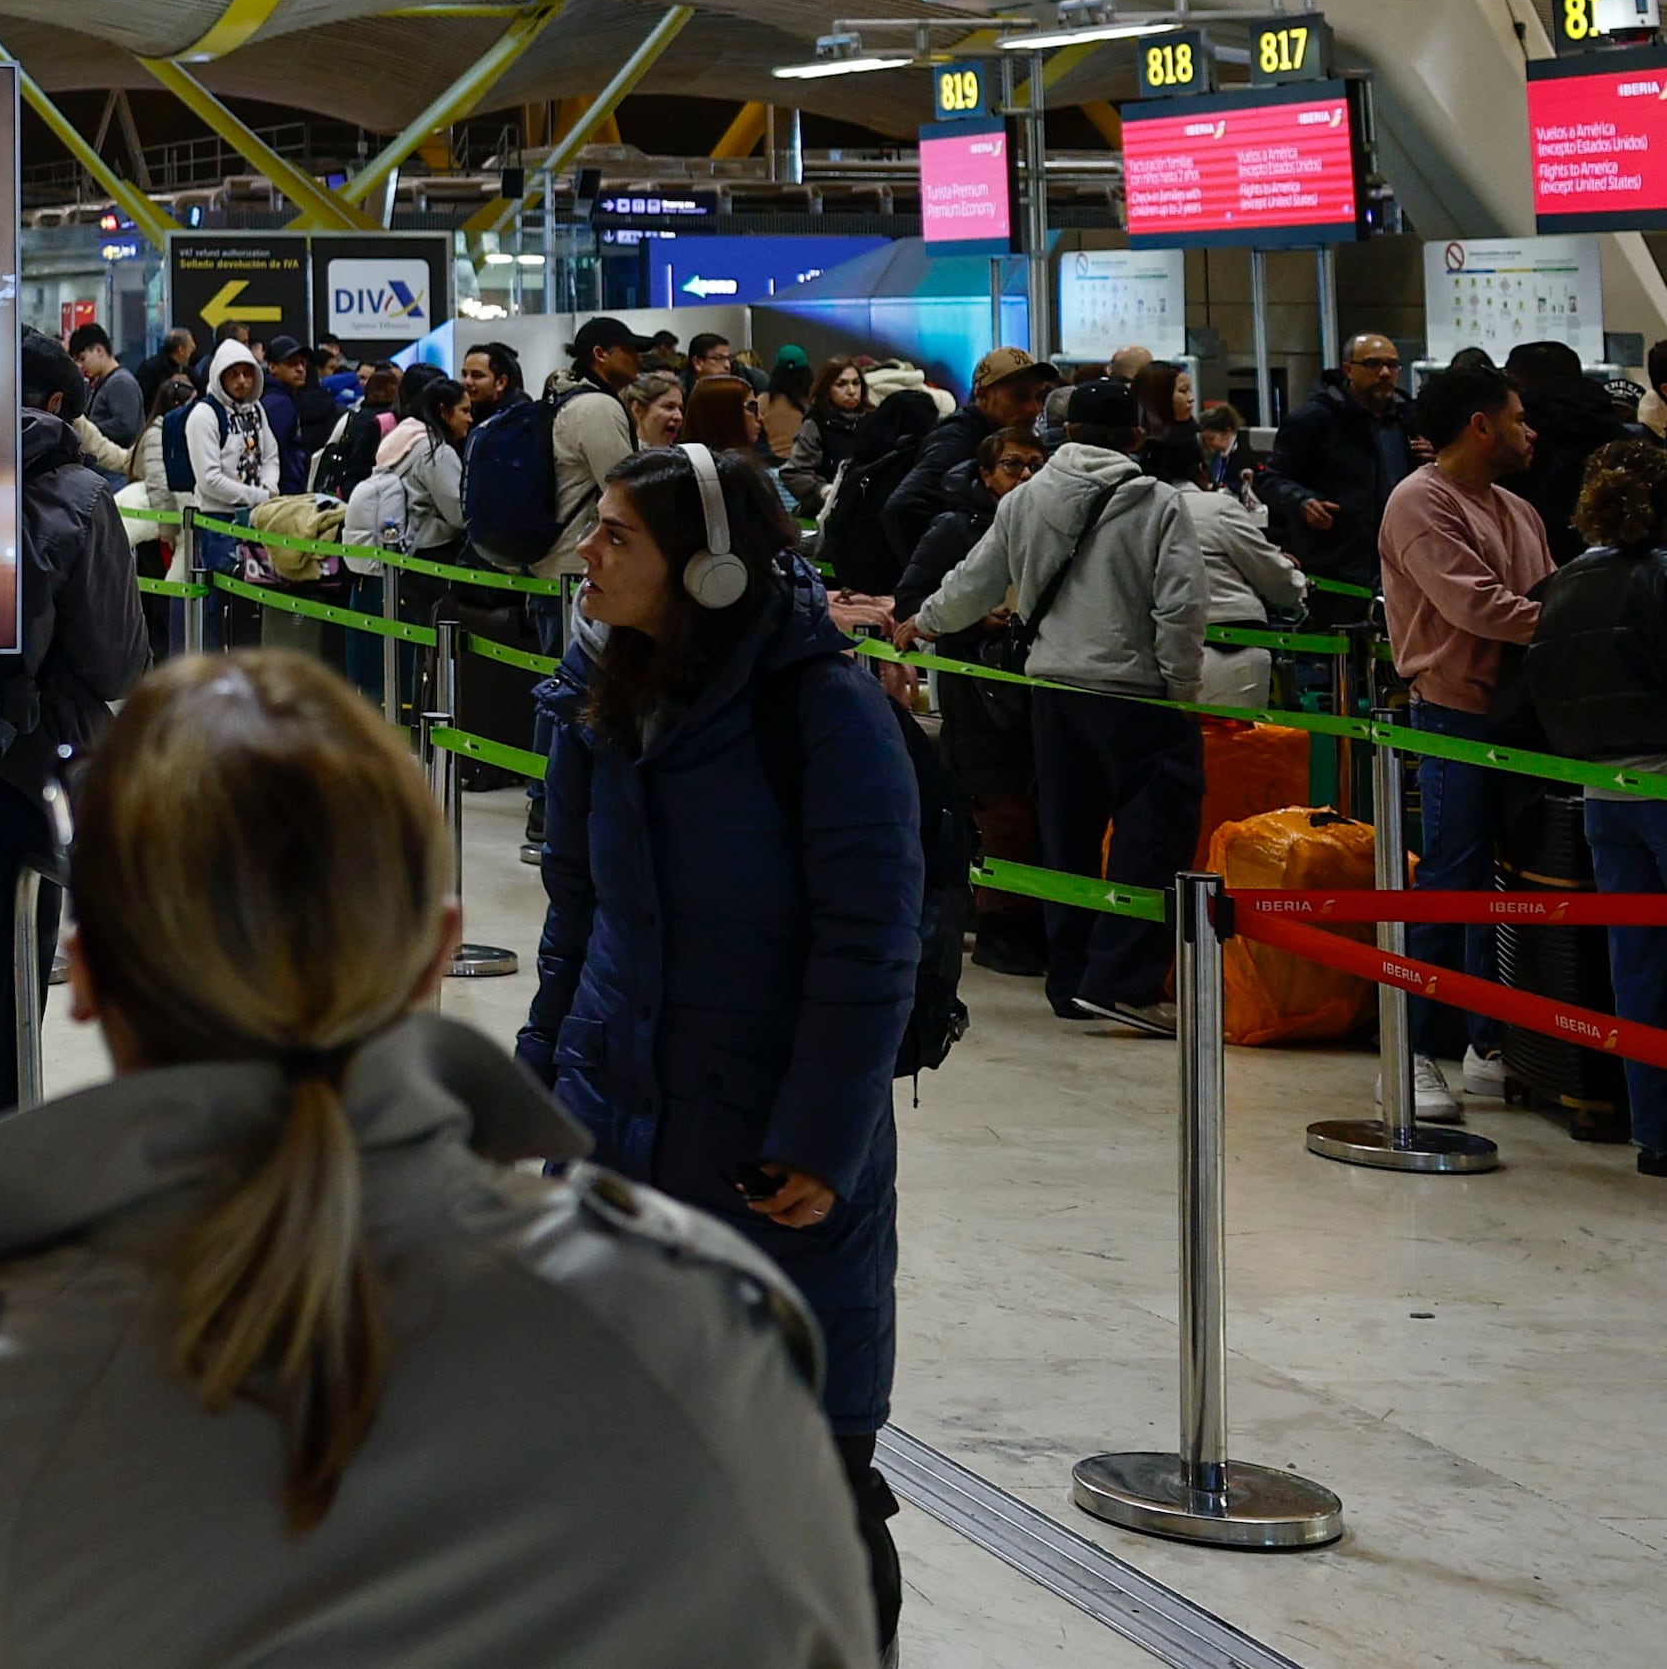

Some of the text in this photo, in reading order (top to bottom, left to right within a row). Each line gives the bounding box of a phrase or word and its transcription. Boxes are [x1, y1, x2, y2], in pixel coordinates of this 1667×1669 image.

[1260, 28, 1307, 73] 817
[1147, 43, 1193, 86] 818
[941, 71, 978, 110] 819
[1619, 81, 1660, 96] IBERIA
[1298, 111, 1330, 124] IBERIA
[1185, 124, 1214, 136] IBERIA
[1537, 127, 1568, 141] Vuelos
[1577, 123, 1615, 138] América
[1538, 135, 1647, 158] (excepto Estados Unidos)
[1539, 165, 1568, 181] Flights
[1581, 160, 1618, 175] America
[1541, 175, 1641, 196] (except United States)
[195, 249, 220, 257] refund
[222, 249, 270, 257] authorization
[218, 259, 267, 269] devolución
[269, 260, 280, 269] de
[284, 261, 299, 269] IVA
[1257, 900, 1312, 912] IBERIA
[1490, 901, 1546, 915] IBERIA
[1383, 962, 1422, 985] IBERIA
[1555, 1014, 1601, 1039] IBERIA
